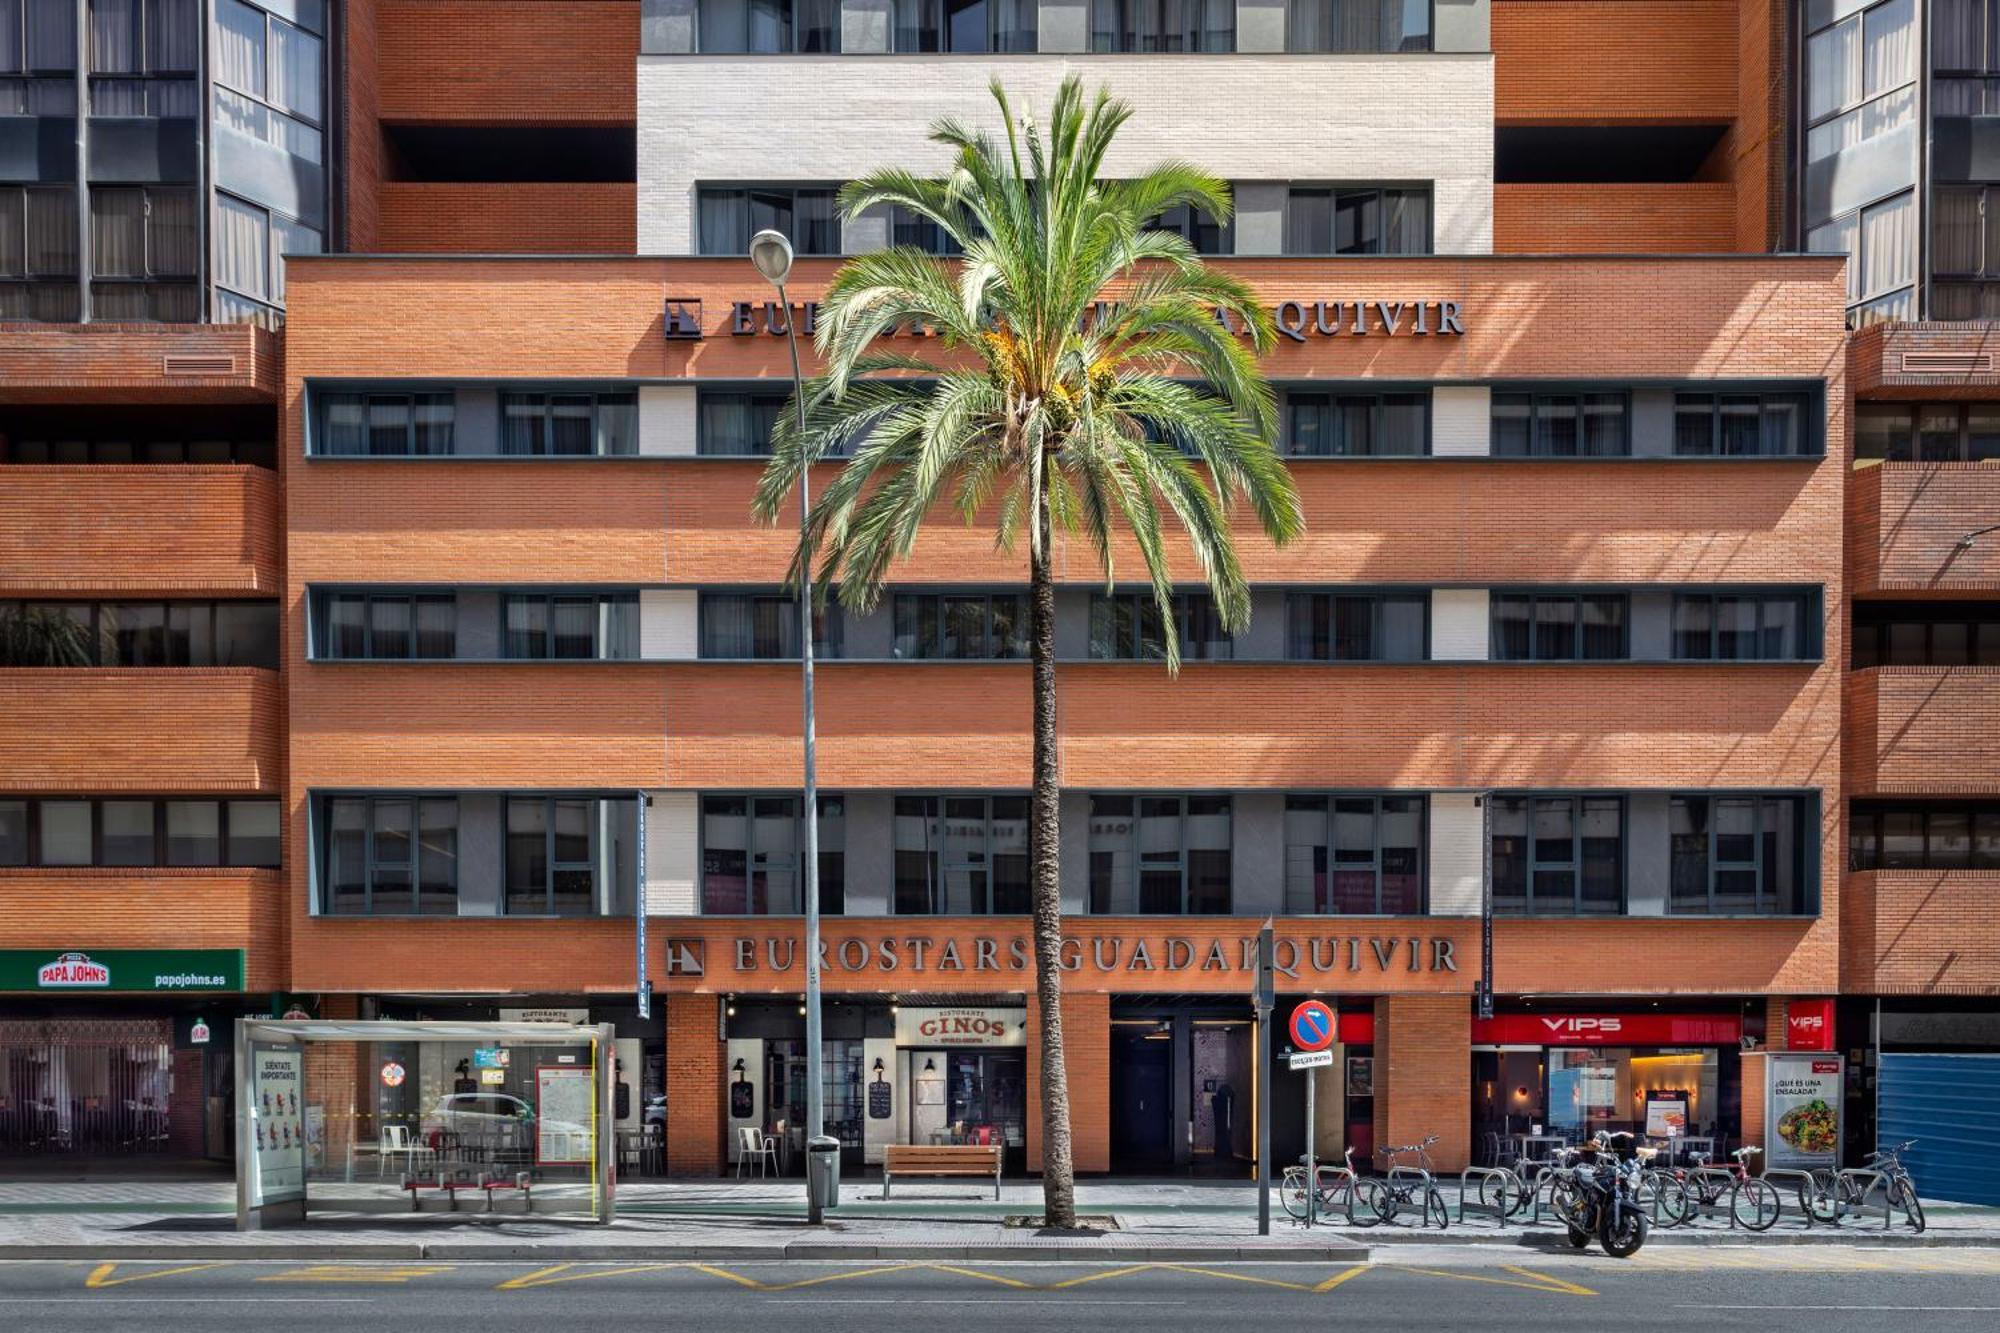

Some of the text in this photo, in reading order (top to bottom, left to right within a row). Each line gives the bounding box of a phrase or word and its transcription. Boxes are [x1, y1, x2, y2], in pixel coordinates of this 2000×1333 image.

[735, 937, 1028, 972] EUROSTARS
[42, 966, 69, 982] PAPA
[155, 972, 226, 988] papajohns.es
[919, 1017, 1005, 1037] GINOS
[1541, 1017, 1622, 1031] VIPS
[1789, 1016, 1823, 1027] VIPS
[1804, 1079, 1822, 1087] UNA
[1775, 1088, 1817, 1096] ENSALADA?
